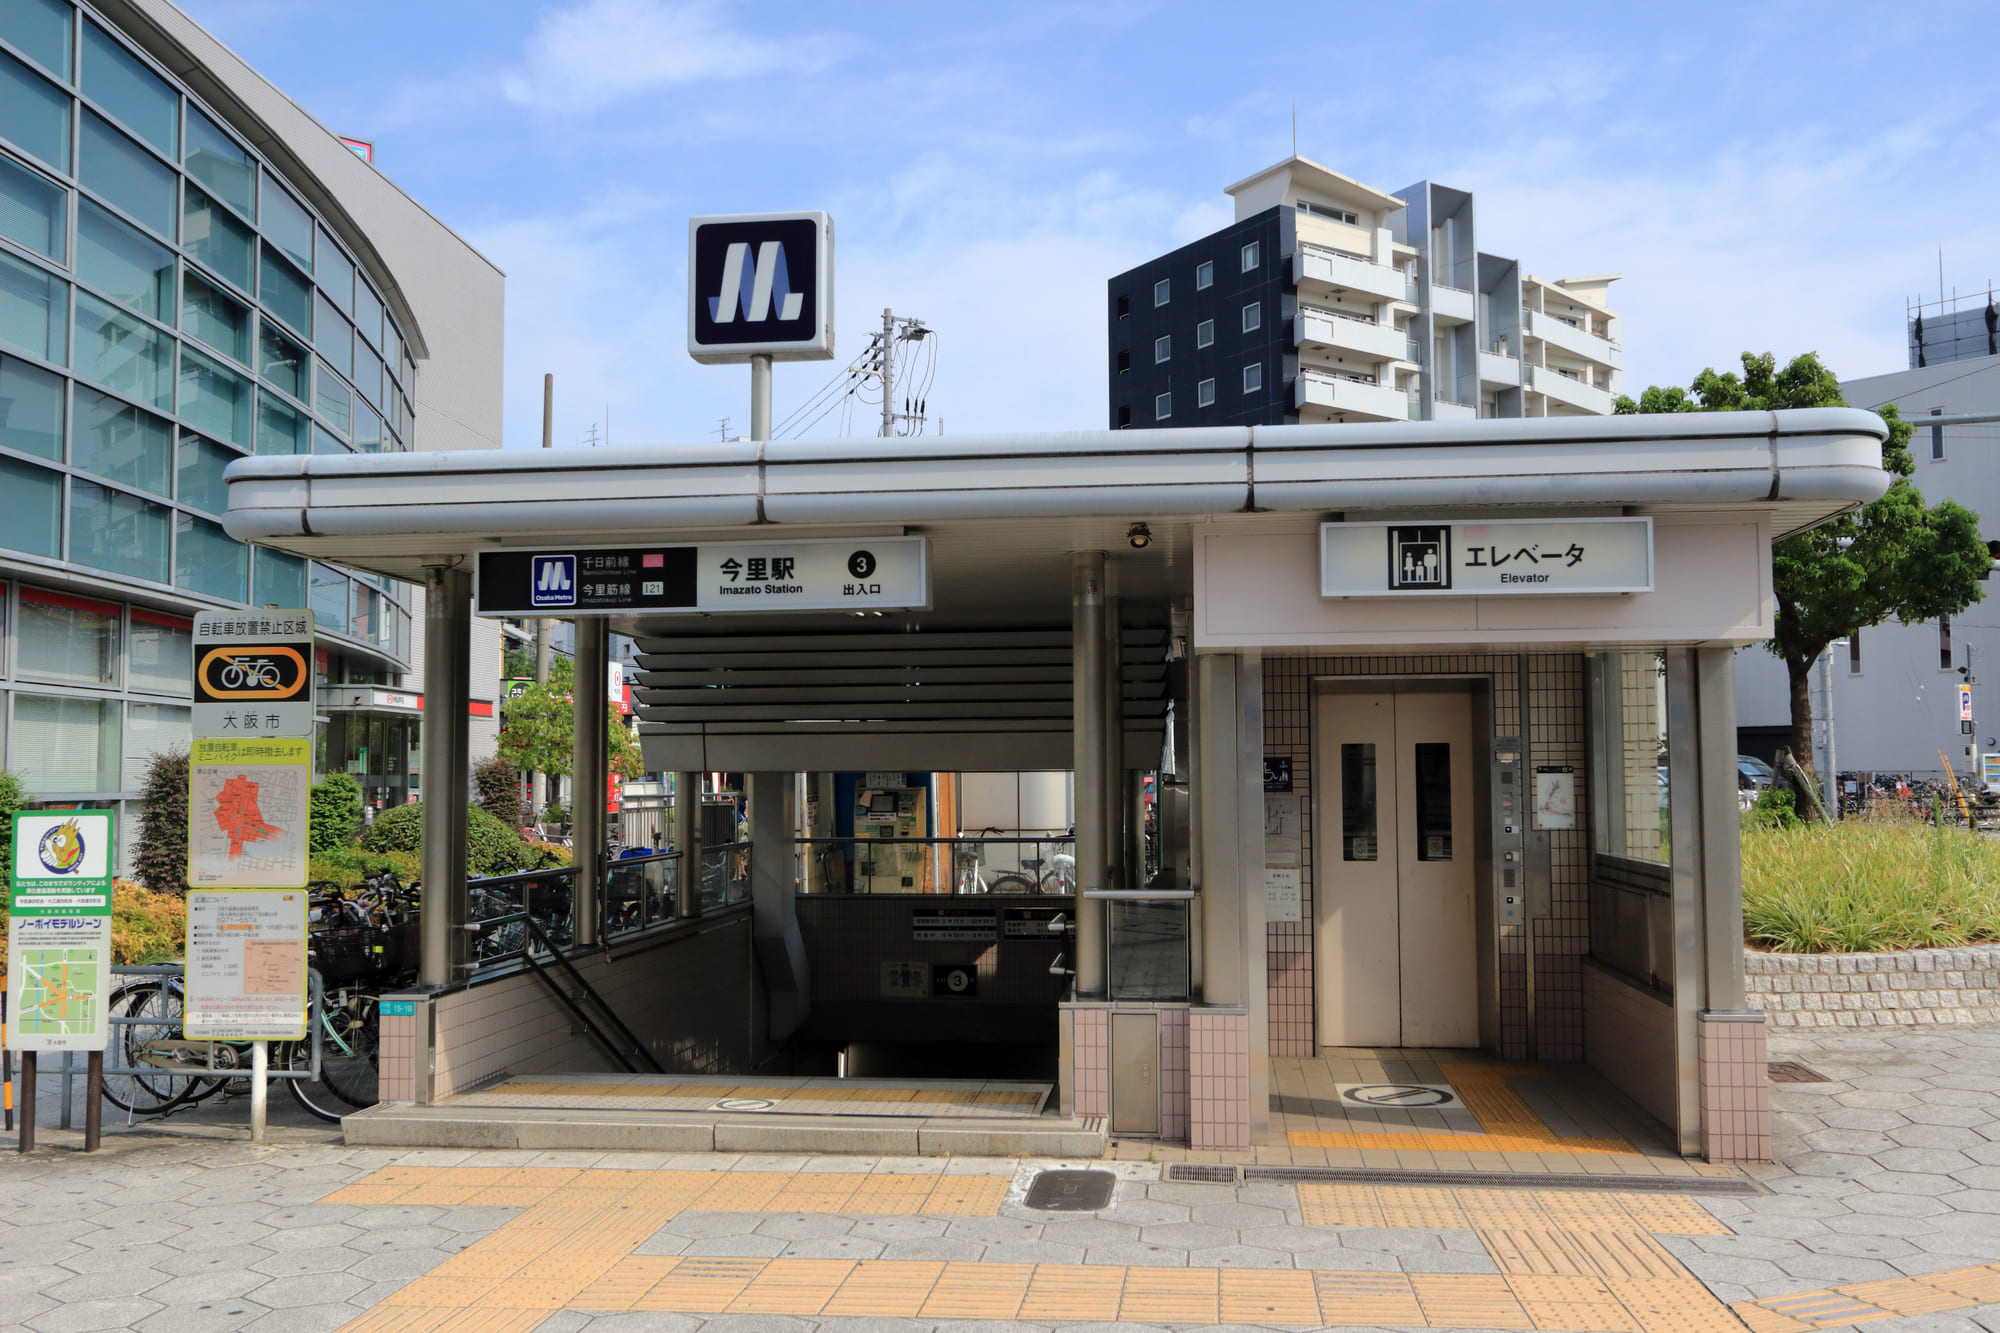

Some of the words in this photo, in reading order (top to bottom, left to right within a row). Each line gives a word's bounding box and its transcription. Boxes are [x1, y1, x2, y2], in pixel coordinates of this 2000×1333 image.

[583, 555, 630, 569] 千日前線
[1465, 543, 1585, 568] エレベータ
[720, 557, 795, 582] 今里駅
[1501, 573, 1550, 584] Elevator
[582, 583, 631, 597] 今里筋線
[719, 584, 761, 596] Imazato
[764, 583, 803, 595] Station
[842, 582, 881, 597] 出入口
[199, 619, 307, 636] 自転車放置禁止区域
[223, 713, 281, 729] 大阪市
